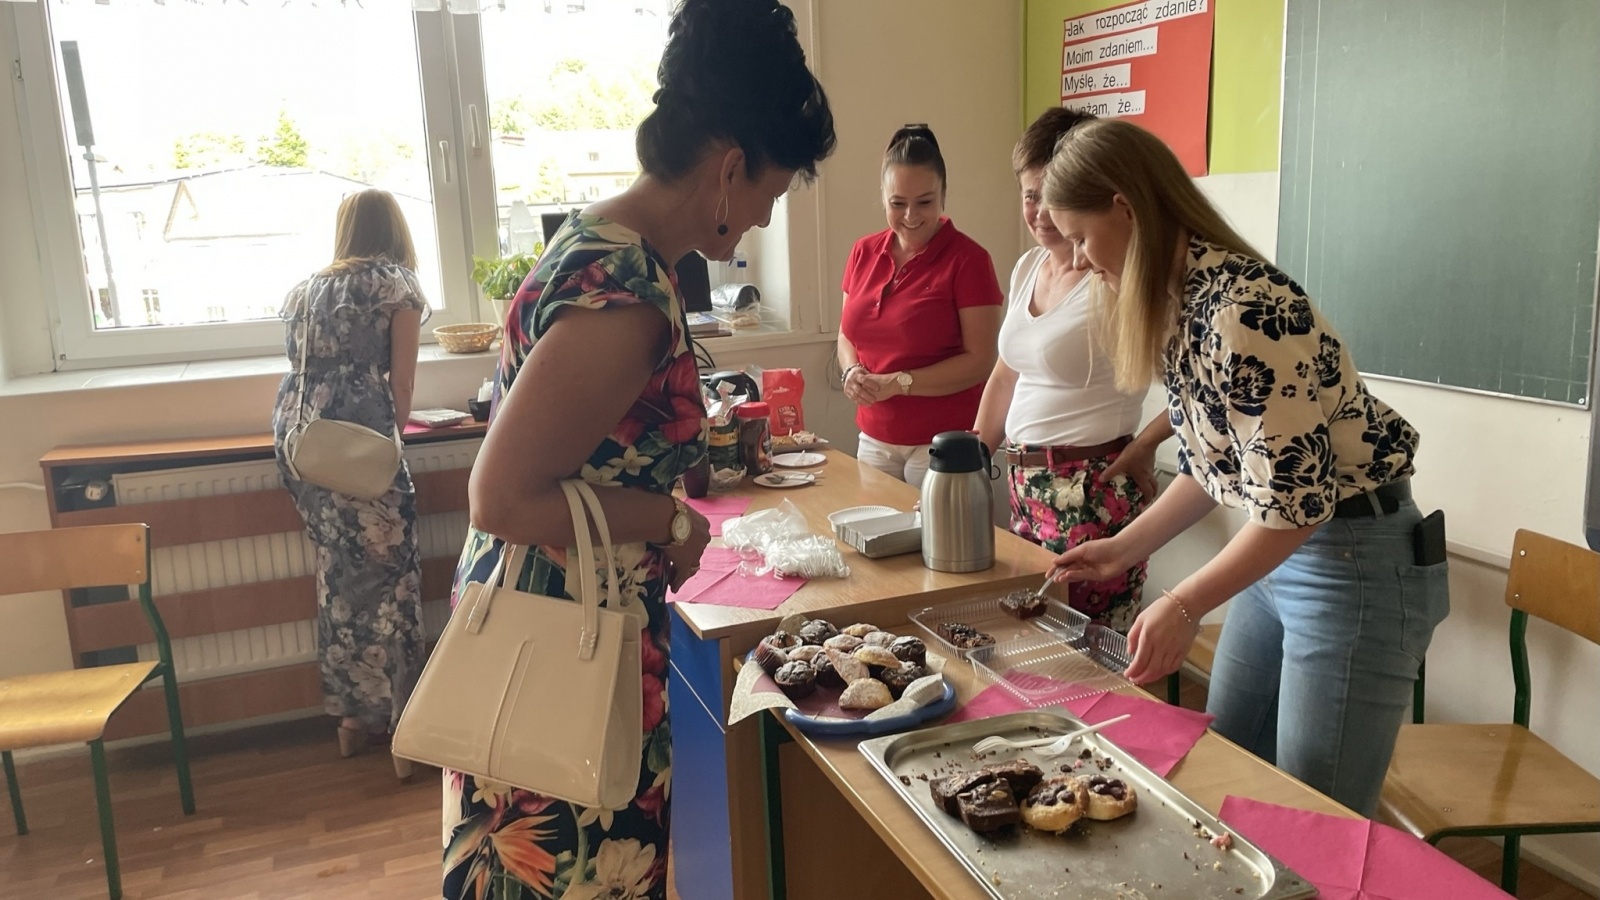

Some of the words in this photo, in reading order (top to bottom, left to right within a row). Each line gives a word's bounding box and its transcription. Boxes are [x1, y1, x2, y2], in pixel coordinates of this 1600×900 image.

[1096, 4, 1148, 30] rozpocząć
[1155, 0, 1203, 19] zdanie?
[1066, 49, 1093, 67] Moim
[1099, 38, 1154, 58] zdaniem...
[1064, 74, 1097, 92] Myślę,
[1103, 73, 1128, 88] że...
[1118, 98, 1141, 114] że...
